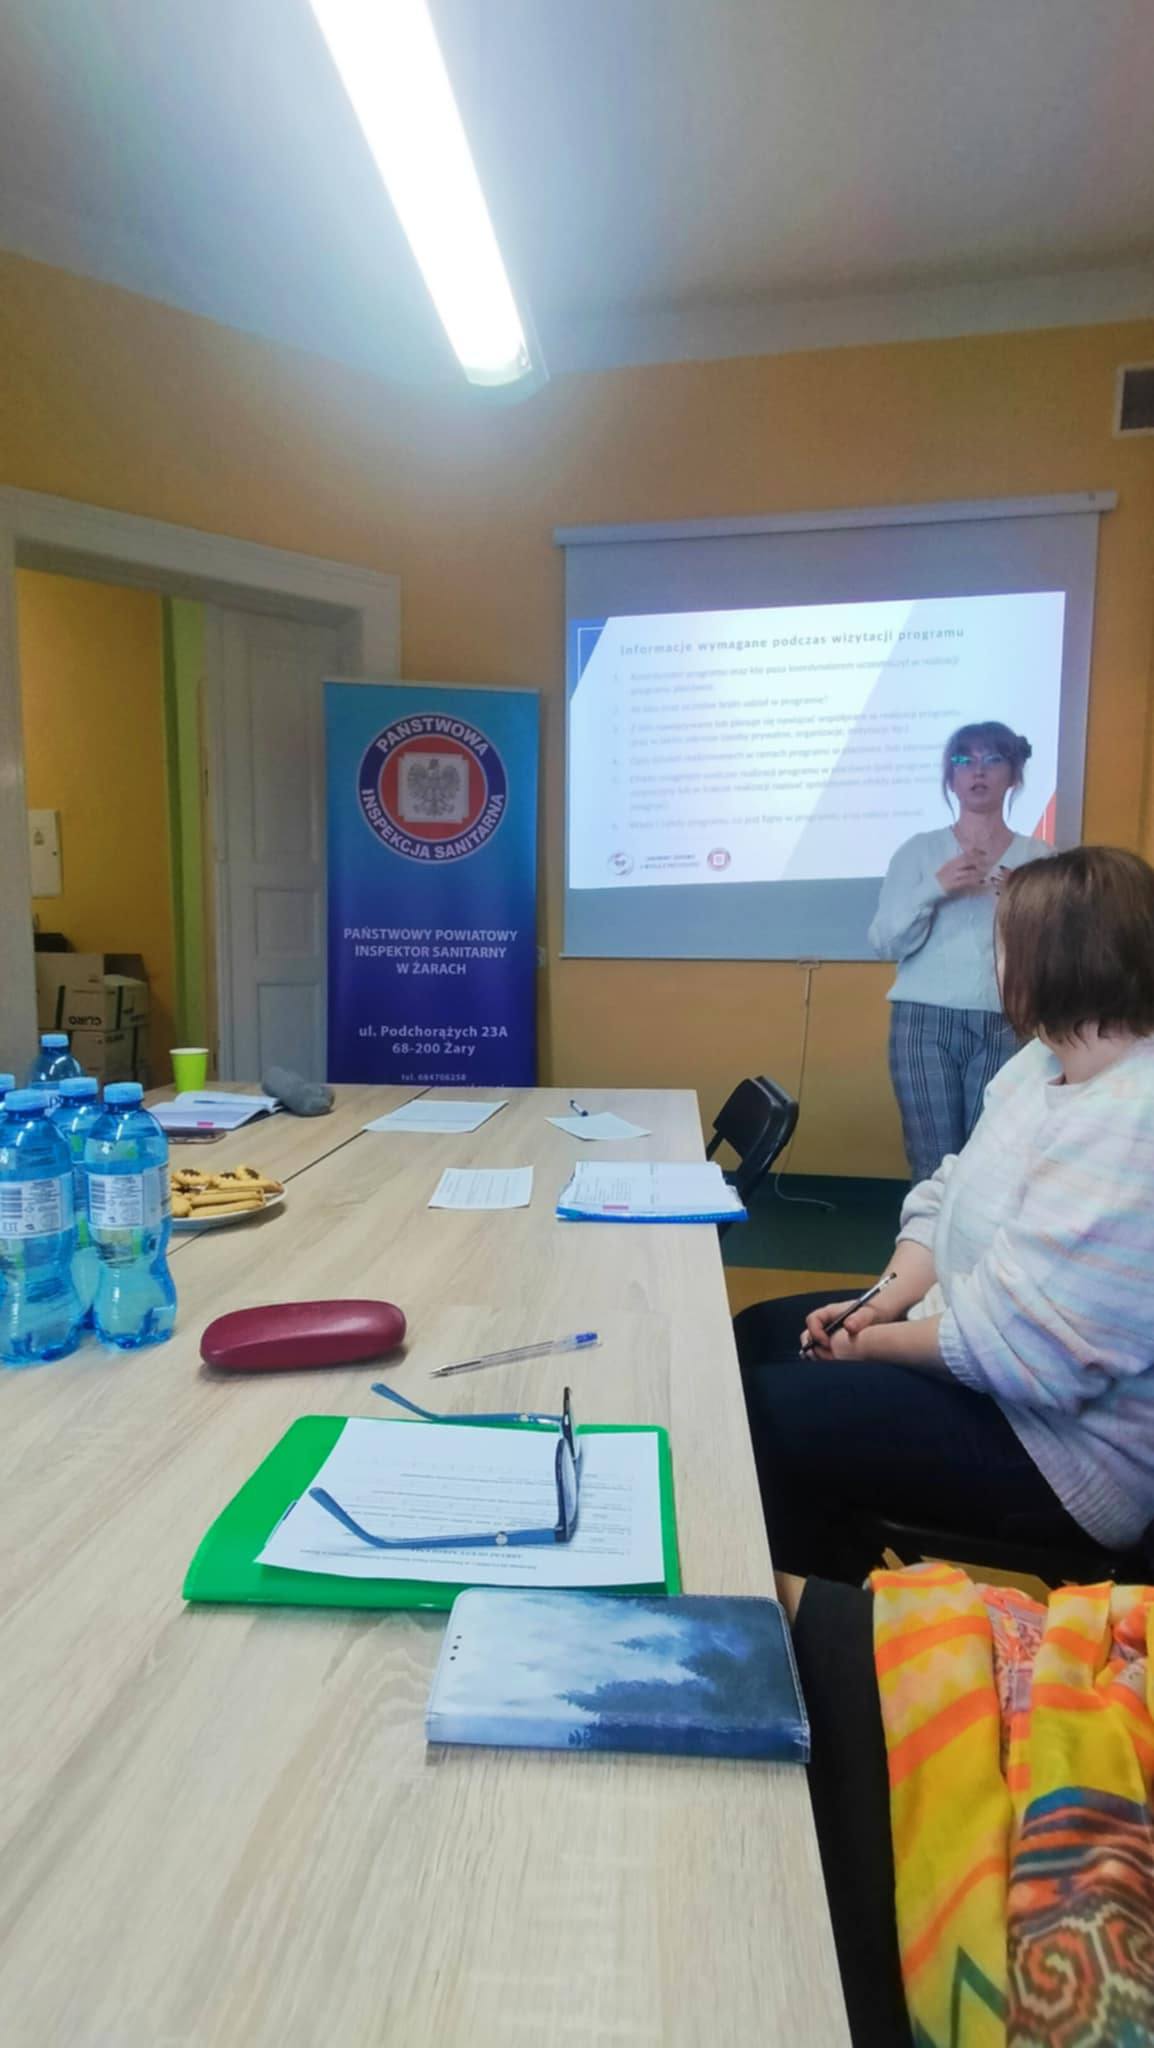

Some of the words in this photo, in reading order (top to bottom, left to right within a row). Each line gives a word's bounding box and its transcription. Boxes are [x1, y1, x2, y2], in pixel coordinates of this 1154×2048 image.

[620, 640, 692, 656] Informacje
[697, 640, 768, 652] wymagane
[772, 635, 827, 649] podczas
[832, 629, 893, 644] wizytacji
[898, 628, 964, 642] programu
[376, 716, 489, 757] PAŃSTWOWA
[360, 788, 431, 860] INSPEKCJA
[433, 793, 505, 860] SANITARNA
[344, 927, 432, 941] PAŃSTWOWY
[435, 929, 518, 942] POWIATOWY
[355, 945, 430, 958] INSPEKTOR
[432, 946, 507, 959] SANITARNY
[396, 964, 410, 975] W
[411, 960, 466, 976] ŻARACH
[359, 1025, 377, 1038] ul.
[381, 1025, 478, 1041] Podchorążych
[481, 1026, 508, 1038] 23A
[392, 1042, 441, 1055] 68-200
[444, 1041, 476, 1057] Żary
